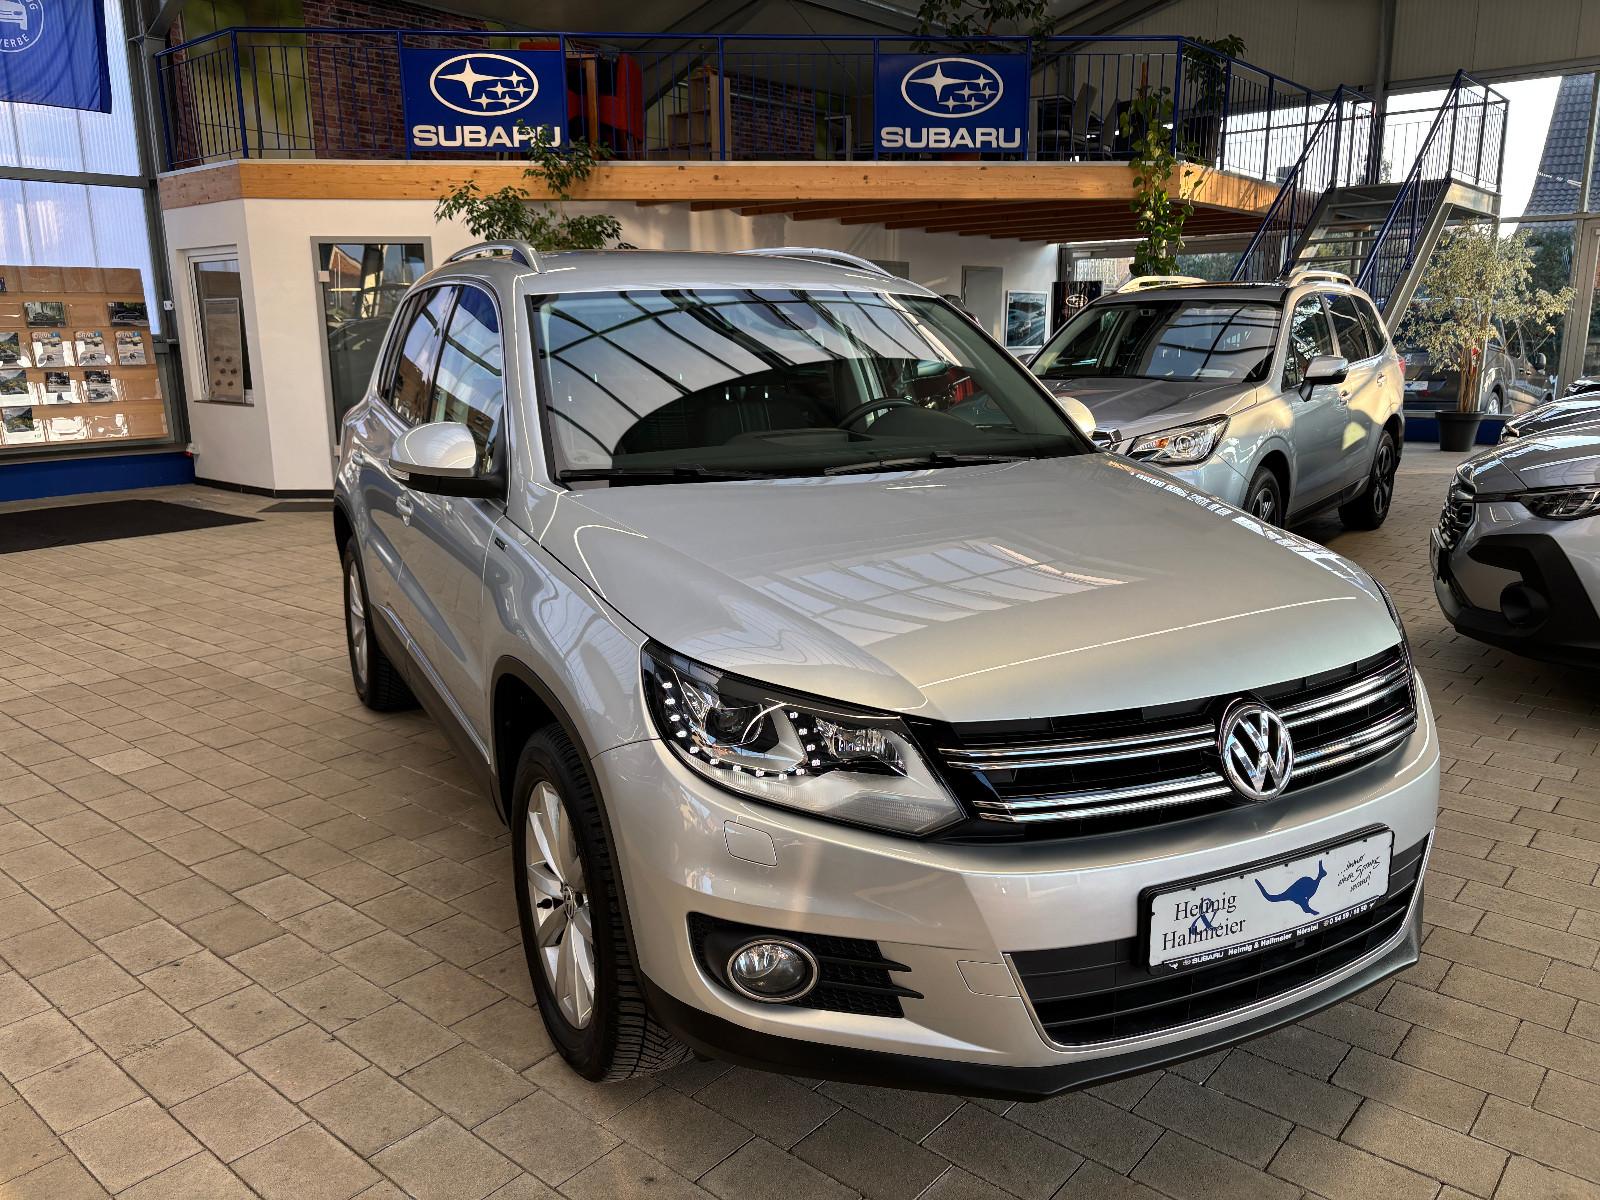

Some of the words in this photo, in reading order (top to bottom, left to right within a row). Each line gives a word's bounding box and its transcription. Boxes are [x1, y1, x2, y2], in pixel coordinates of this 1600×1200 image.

[0, 33, 30, 47] ERBE
[880, 127, 1021, 148] SUBARU
[1174, 892, 1237, 922] Helmig
[1162, 917, 1246, 951] Hallmeier
[1192, 952, 1223, 964] SUBARU
[1228, 944, 1252, 956] Helmig
[1261, 932, 1293, 947] Hallmeier
